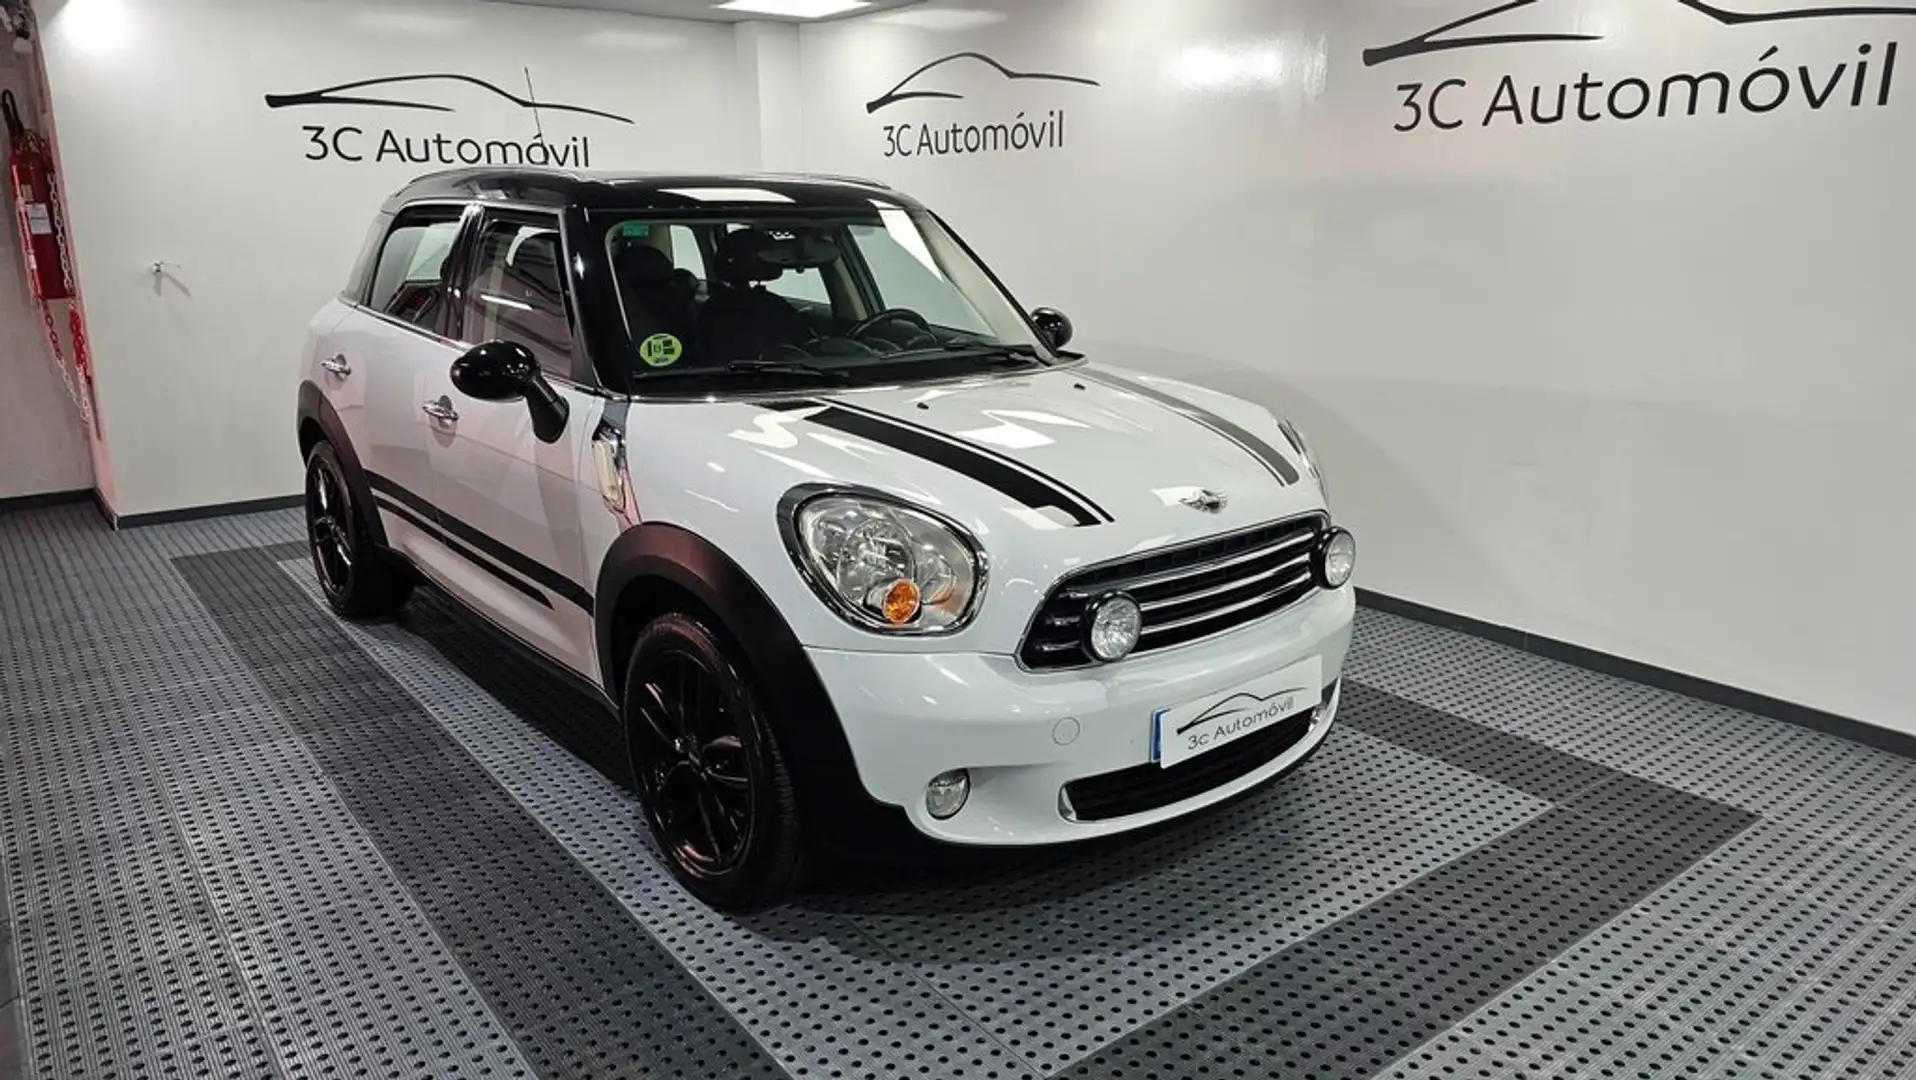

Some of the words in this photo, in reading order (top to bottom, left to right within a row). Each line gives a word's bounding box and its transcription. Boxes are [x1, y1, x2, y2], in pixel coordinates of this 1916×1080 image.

[1393, 78, 1467, 132] 3C
[1482, 41, 1898, 127] Automóvil
[302, 125, 363, 161] 3C
[376, 129, 590, 168] Automóvil
[883, 124, 912, 157] 3C
[917, 110, 1064, 156] Automóvil
[1213, 697, 1295, 741] Automóvil
